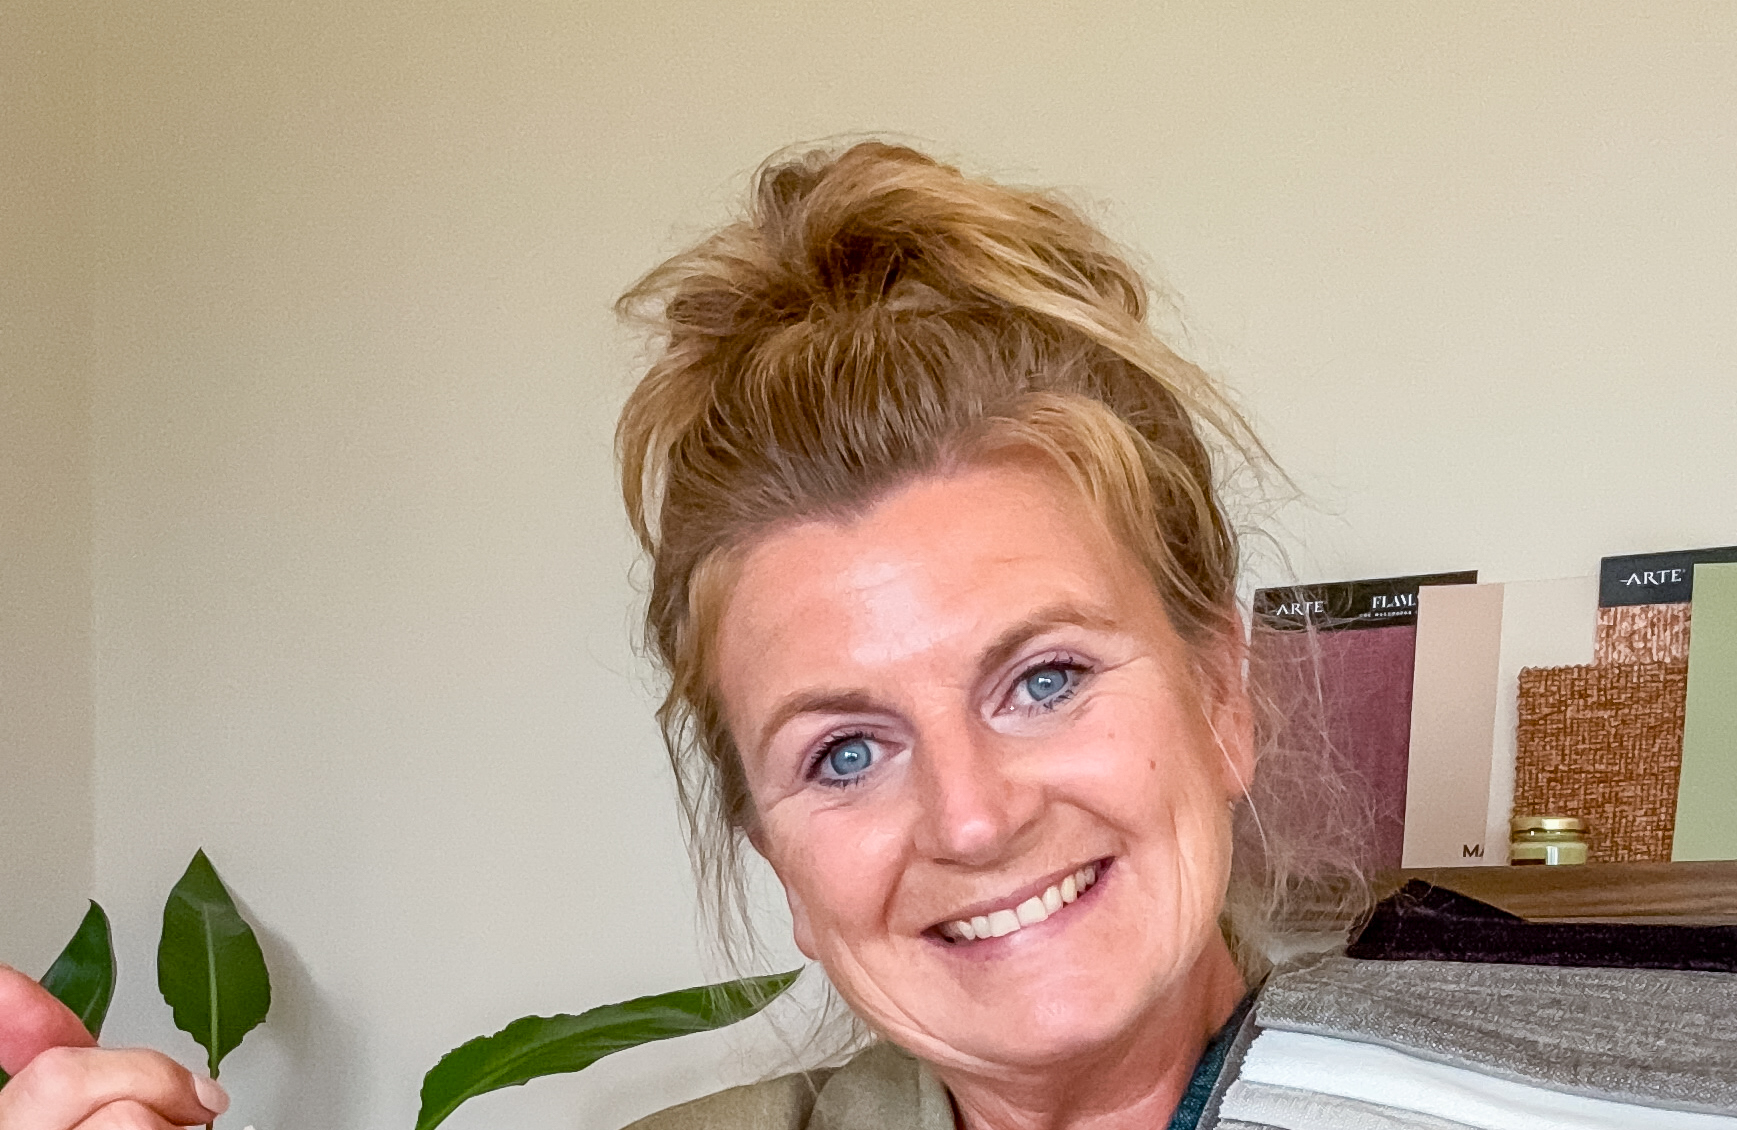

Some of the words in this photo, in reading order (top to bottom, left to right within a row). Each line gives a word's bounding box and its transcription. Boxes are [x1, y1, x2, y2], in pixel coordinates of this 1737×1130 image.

[1619, 568, 1683, 586] ARTE
[1275, 601, 1324, 616] ARTE
[1372, 593, 1417, 609] FLAM
